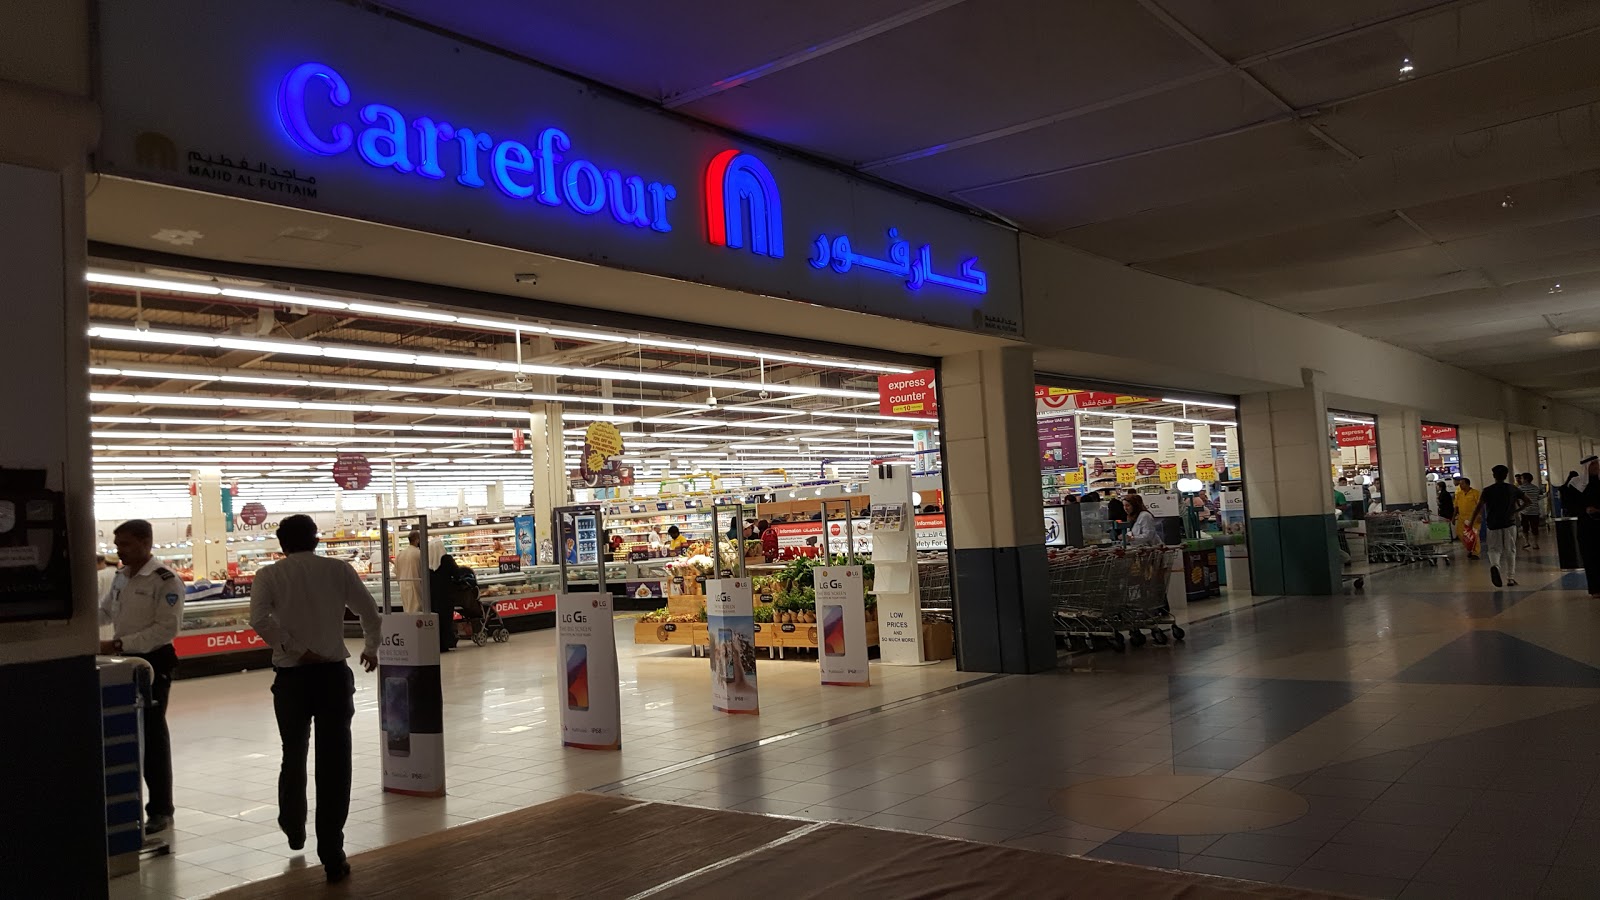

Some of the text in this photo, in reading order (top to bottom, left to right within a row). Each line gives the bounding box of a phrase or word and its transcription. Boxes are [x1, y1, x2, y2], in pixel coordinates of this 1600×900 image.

[276, 61, 677, 233] Carrefour
[188, 165, 318, 199] MAJID AL FUTTAIM
[809, 227, 989, 295] كارفور
[888, 379, 926, 391] express
[889, 392, 926, 404] counter
[1365, 429, 1373, 440] 1
[820, 582, 829, 590] LG
[496, 601, 519, 612] DEAL
[523, 600, 544, 612] عرض
[562, 614, 572, 623] LG
[207, 634, 241, 648] DEAL
[381, 637, 391, 646] LG
